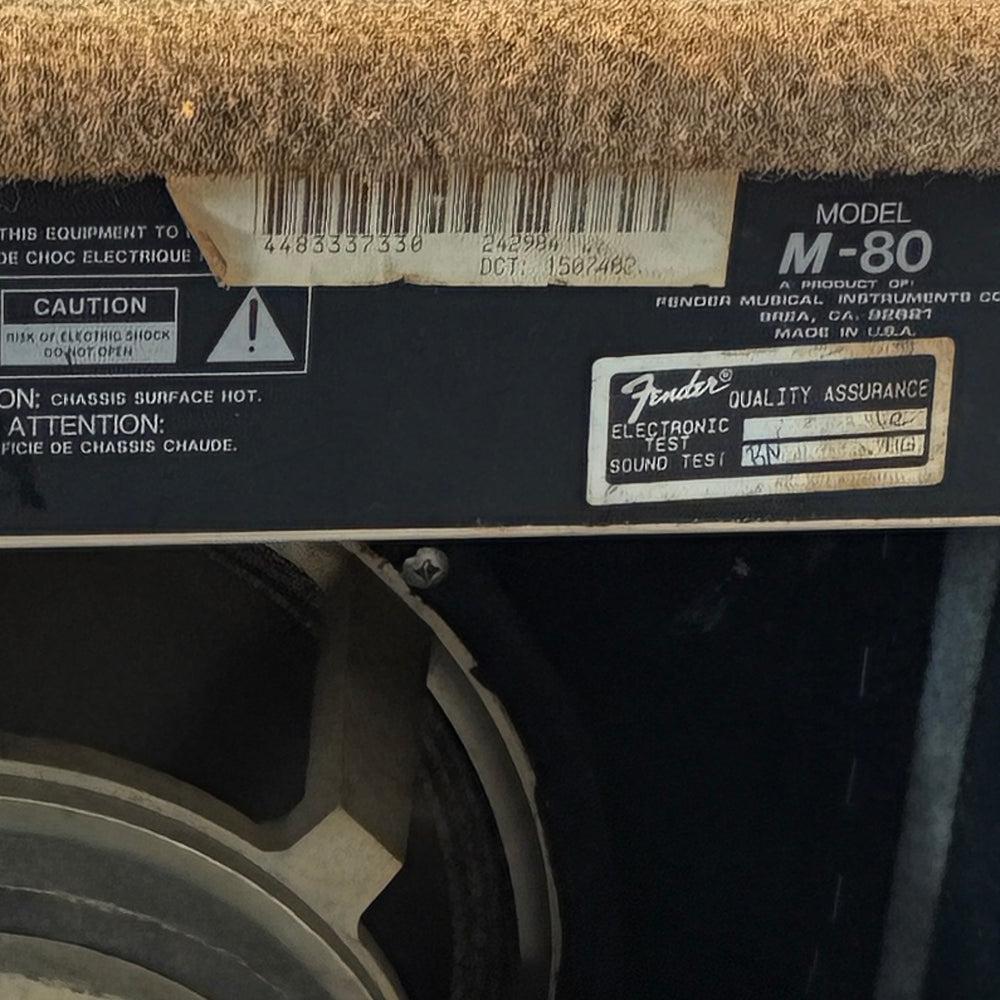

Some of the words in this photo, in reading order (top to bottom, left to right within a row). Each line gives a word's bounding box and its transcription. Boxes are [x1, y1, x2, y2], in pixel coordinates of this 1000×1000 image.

[816, 202, 911, 225] MODEL
[45, 225, 147, 241] EQUIPMENT
[154, 225, 180, 239] TO
[25, 250, 76, 265] CHOC
[83, 248, 191, 264] ELECTRIQUE
[778, 230, 933, 274] M-80
[801, 280, 878, 290] PRODUCT
[34, 296, 148, 316] CAUTION
[656, 296, 732, 307] FENDER
[740, 294, 824, 306] MUSICAL
[838, 292, 971, 305] INSTRUMENTS
[775, 327, 828, 339] MADE
[840, 326, 858, 338] IN
[51, 391, 126, 407] CHASSIS
[135, 390, 213, 405] SURFACE
[221, 389, 262, 404] HOT.
[729, 386, 813, 409] QUALITY
[824, 378, 930, 403] ASSURANCE
[8, 413, 164, 437] ATTENTION:
[611, 417, 730, 440] ELECTRONIC
[51, 441, 73, 455] DE
[80, 439, 156, 455] CHASSIS
[164, 438, 238, 454] CHAUDE.
[645, 436, 689, 452] TEST
[609, 455, 668, 475] SOUND
